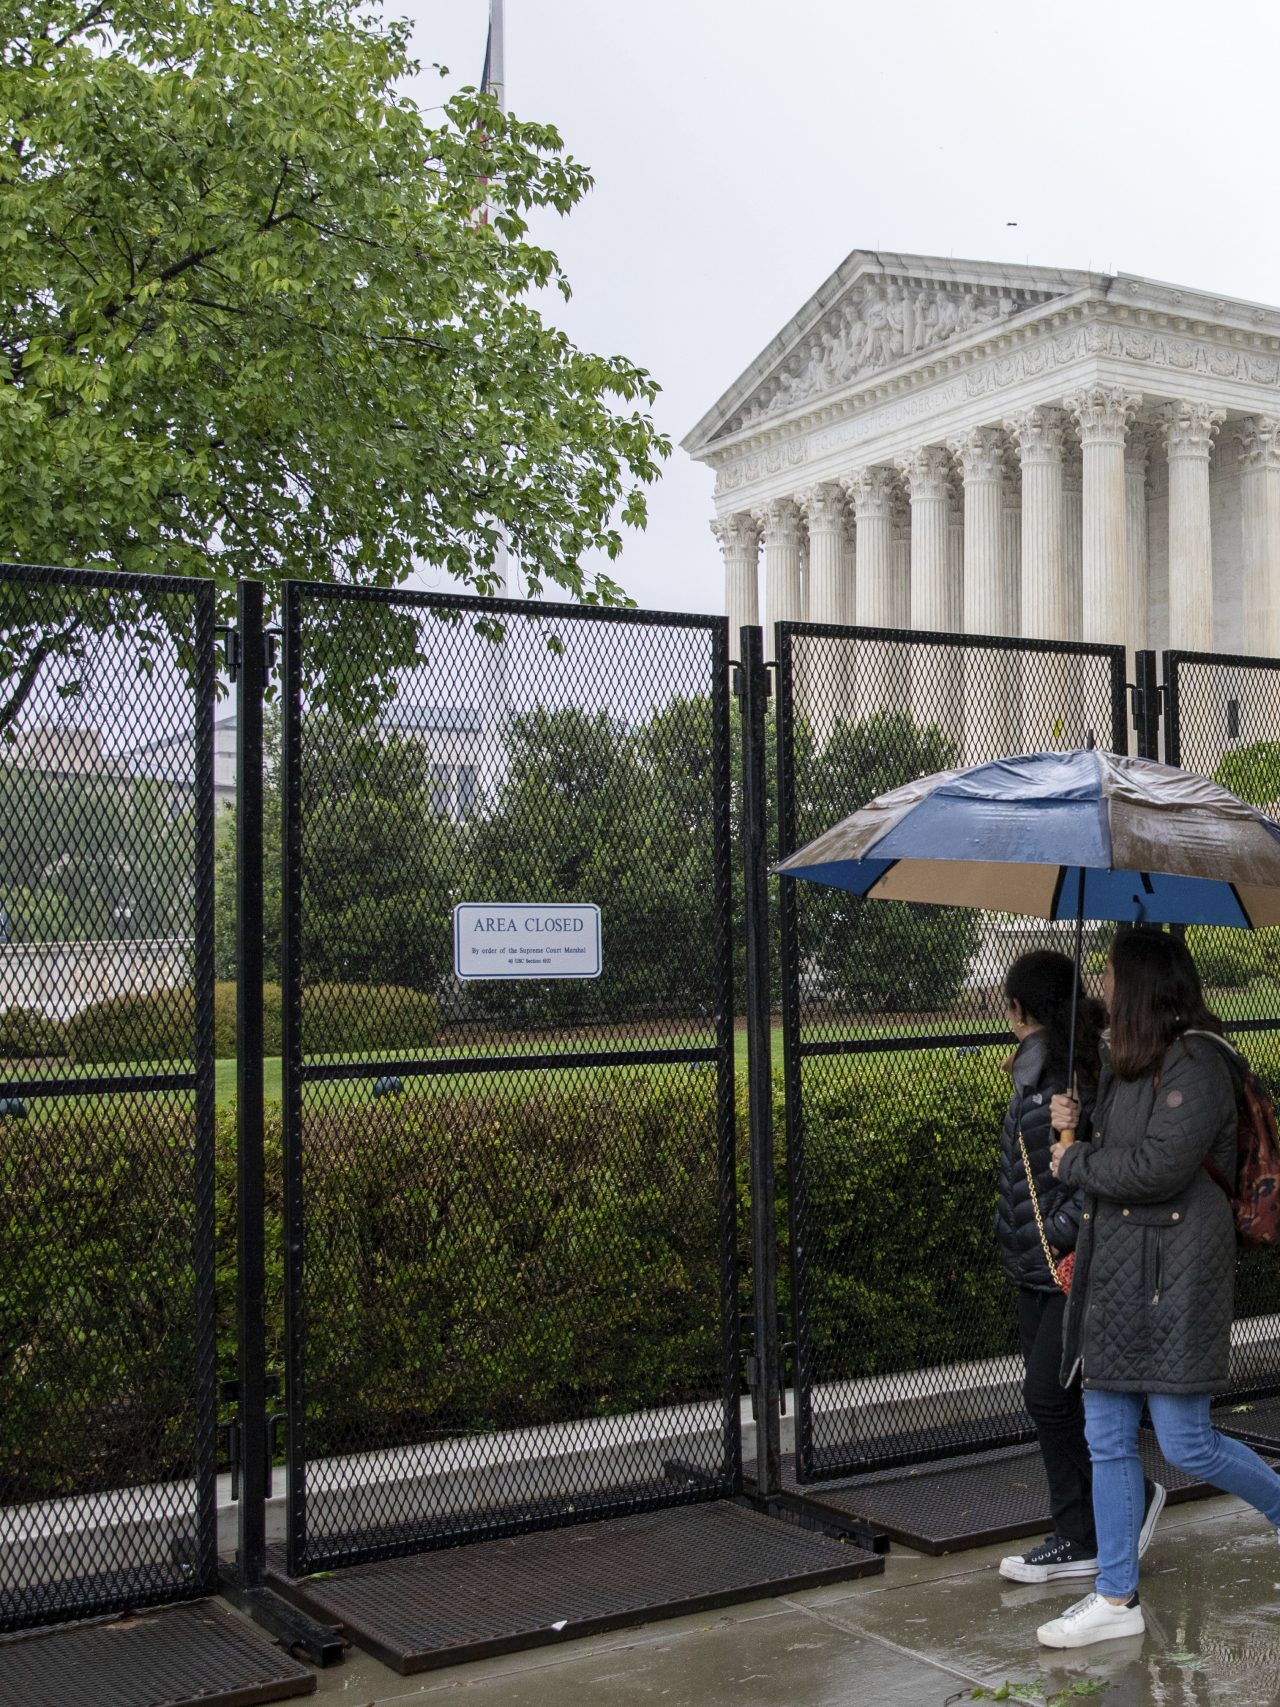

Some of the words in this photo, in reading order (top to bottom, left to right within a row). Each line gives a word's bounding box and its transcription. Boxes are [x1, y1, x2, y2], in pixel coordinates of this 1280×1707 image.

[896, 396, 932, 421] UNDER
[935, 386, 956, 407] LAW
[474, 918, 517, 932] AREA
[524, 918, 584, 932] CLOSED
[472, 947, 479, 955] By
[519, 947, 544, 955] Supreme
